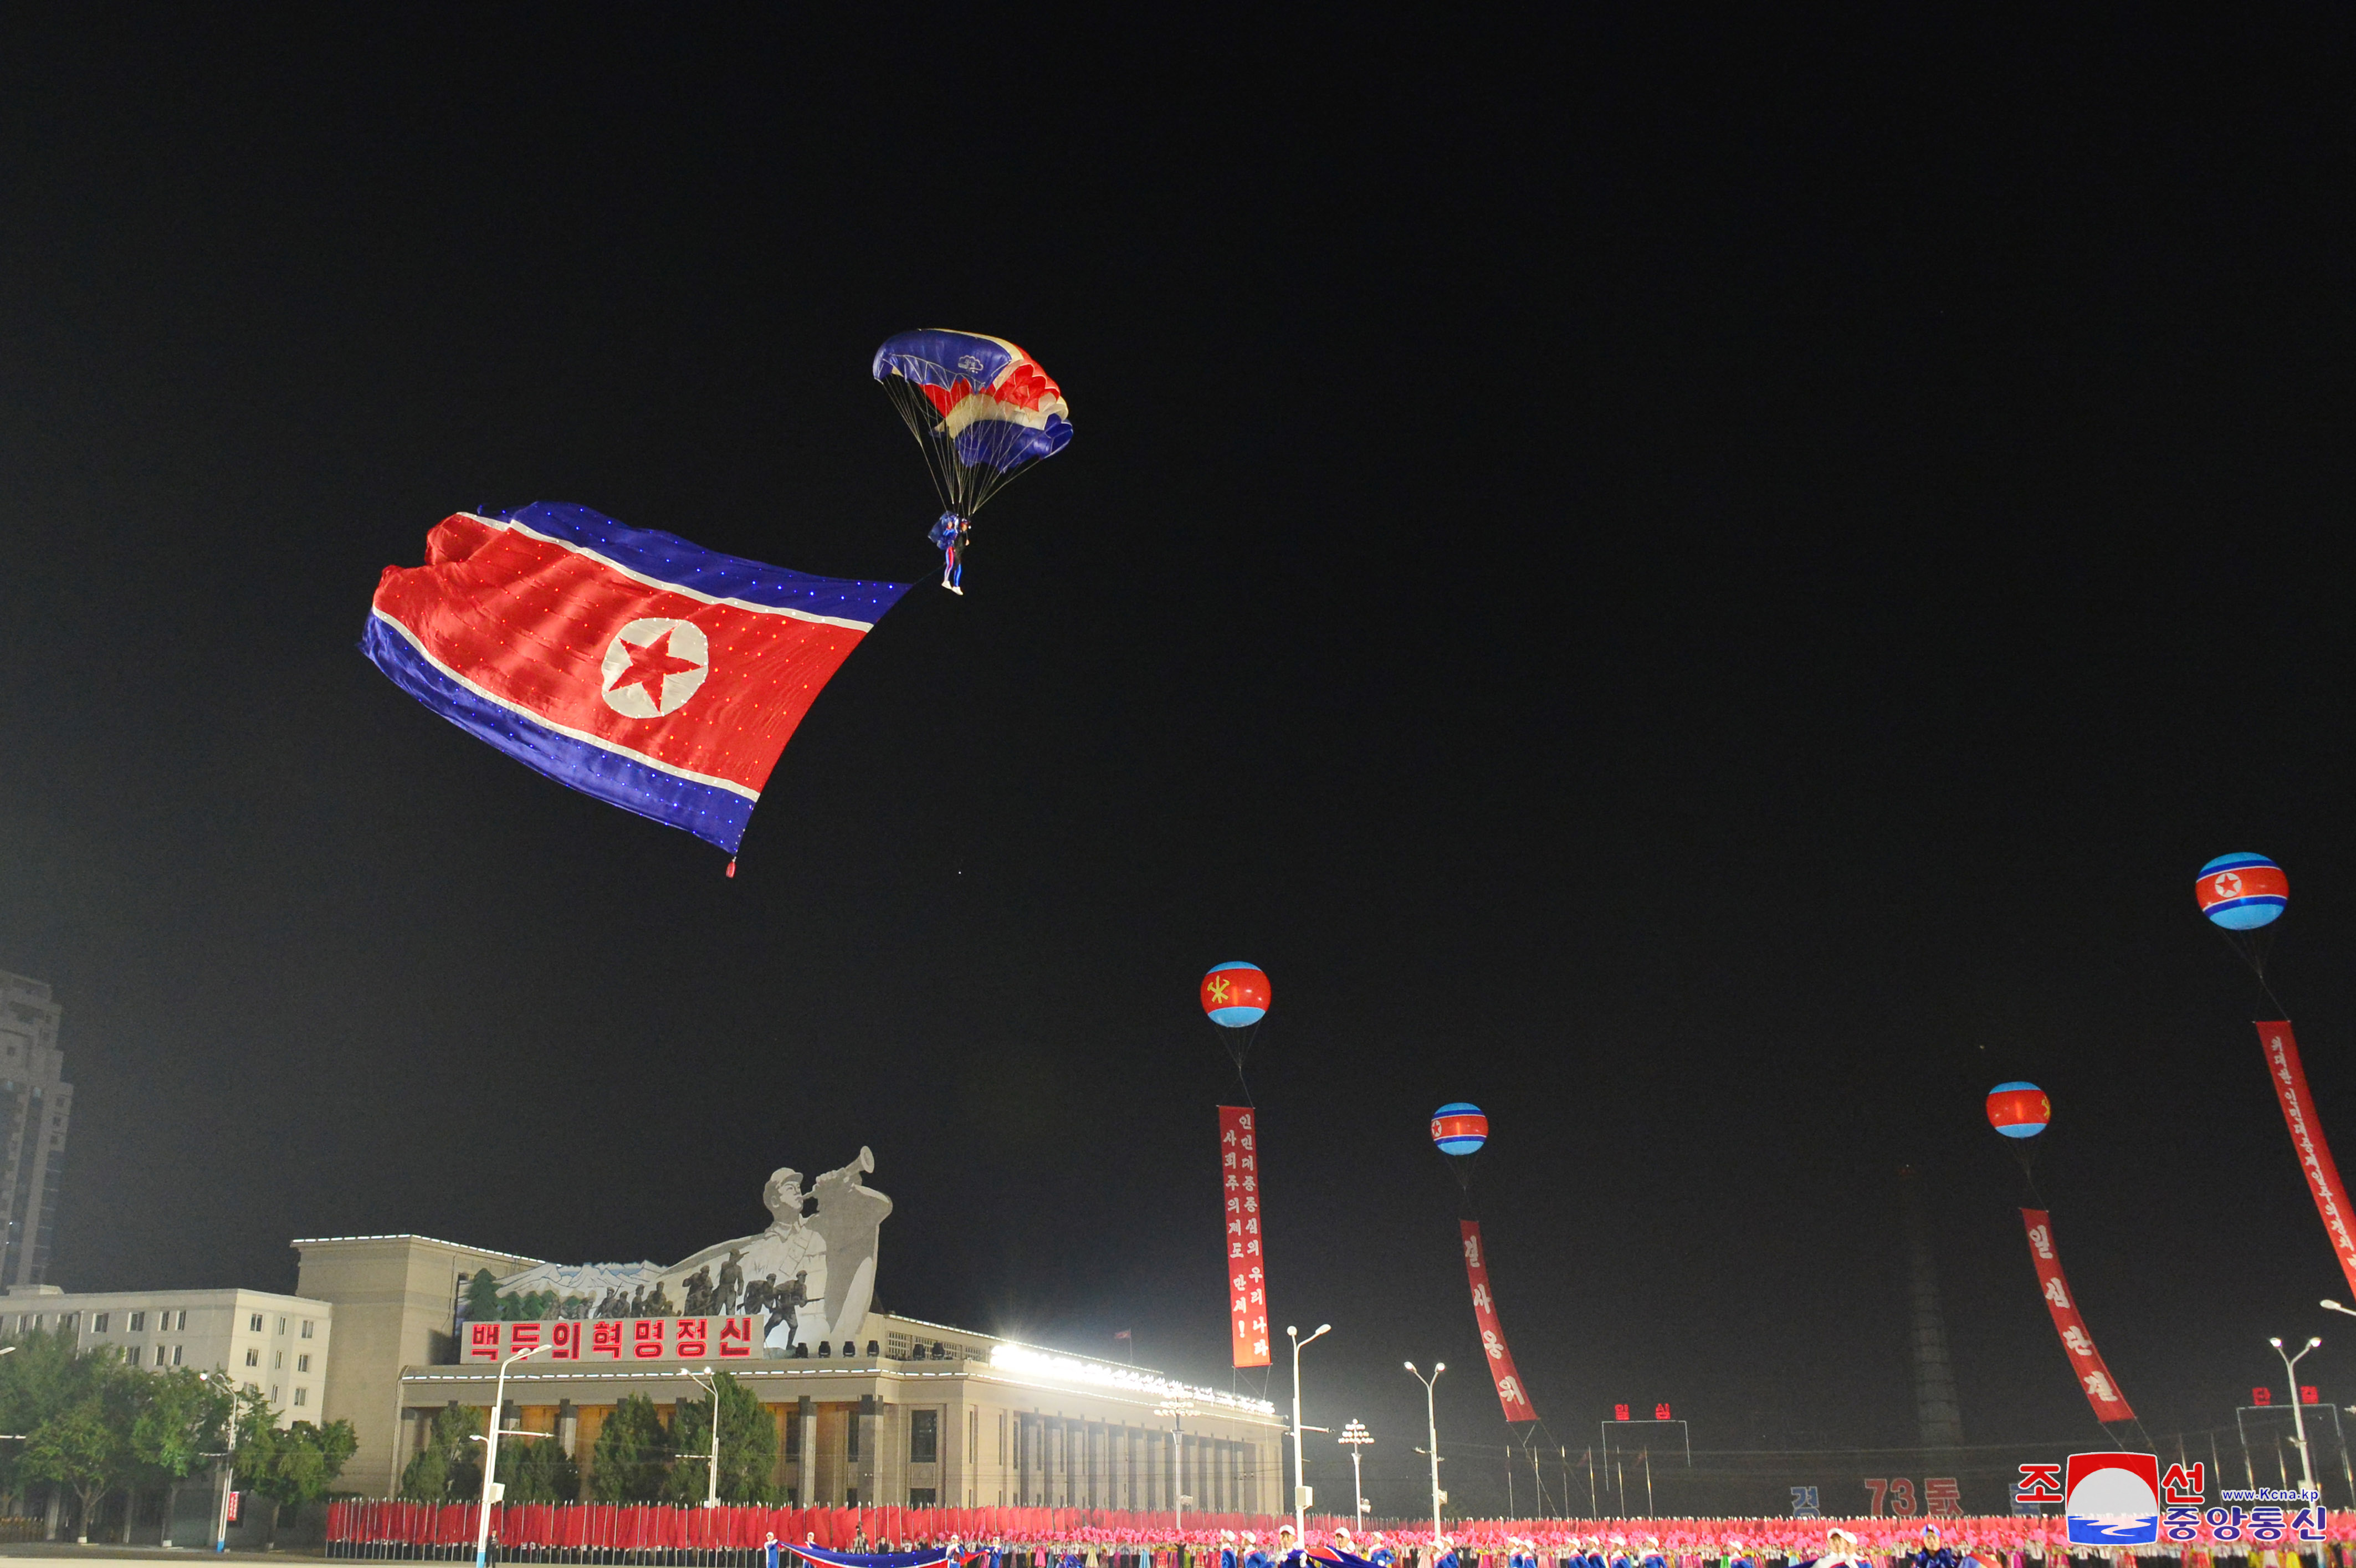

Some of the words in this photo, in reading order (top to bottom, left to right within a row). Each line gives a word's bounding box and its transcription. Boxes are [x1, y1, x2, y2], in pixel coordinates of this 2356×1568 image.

[1232, 1274, 1247, 1338] 만세!
[1248, 1266, 1263, 1305] 우리
[1252, 1315, 1269, 1357] 나라
